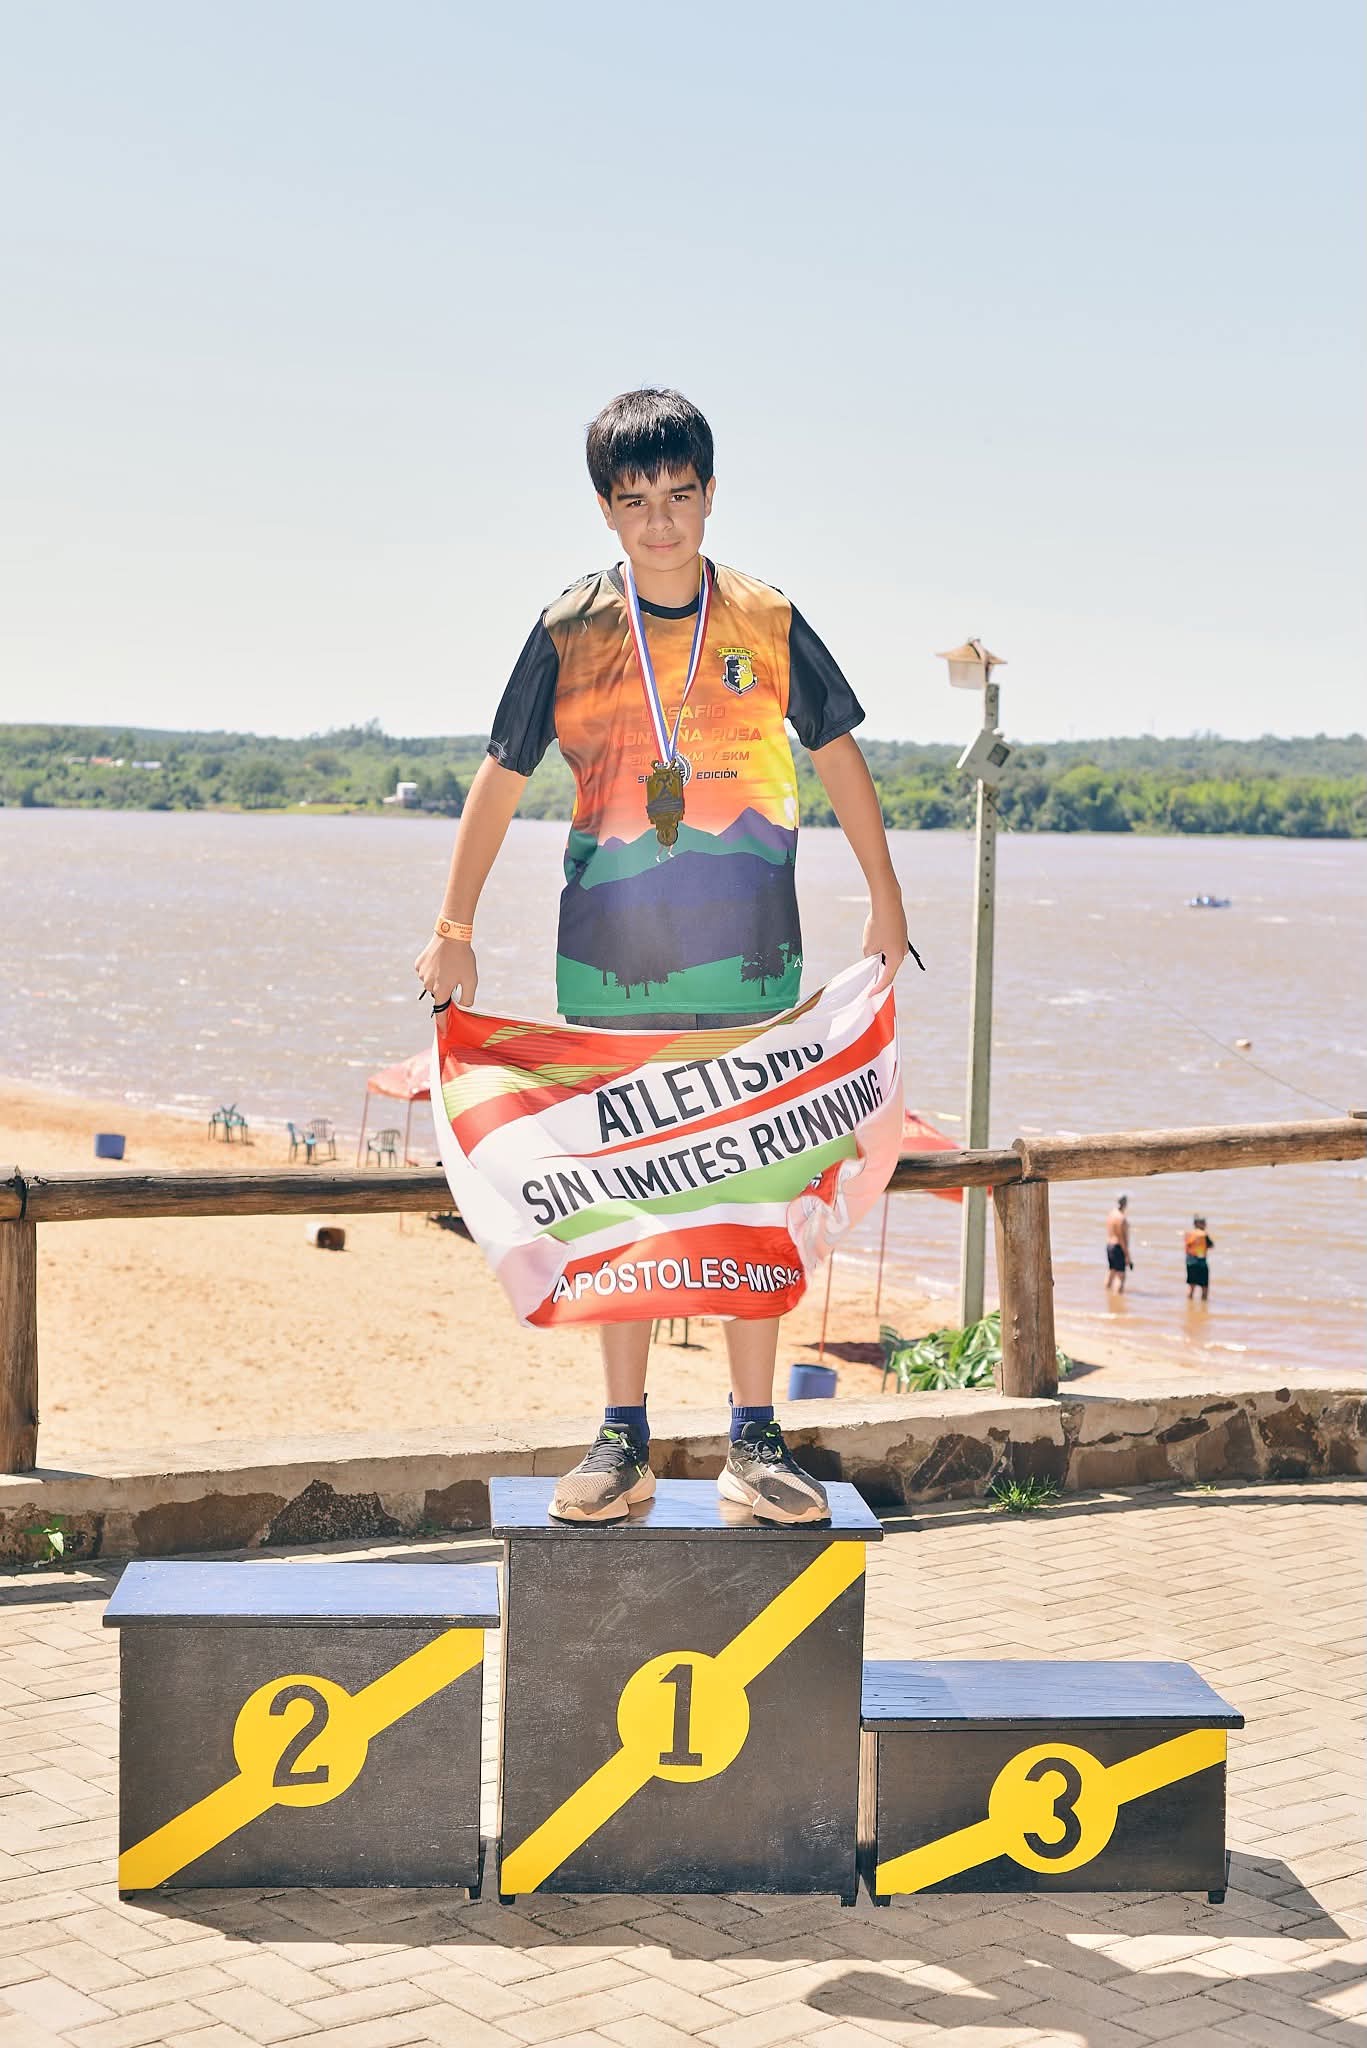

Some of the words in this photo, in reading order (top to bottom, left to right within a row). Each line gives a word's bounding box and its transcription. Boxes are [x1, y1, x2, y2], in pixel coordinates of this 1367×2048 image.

[696, 767, 738, 779] EDICIÓN
[711, 727, 762, 741] RUSA
[721, 751, 750, 761] 5KM
[522, 1169, 593, 1226] SIN
[591, 1135, 746, 1200] LIMITES
[749, 1068, 883, 1166] RUNNING
[268, 1684, 330, 1787] 2
[658, 1663, 704, 1766] 1
[1024, 1758, 1082, 1860] 3
